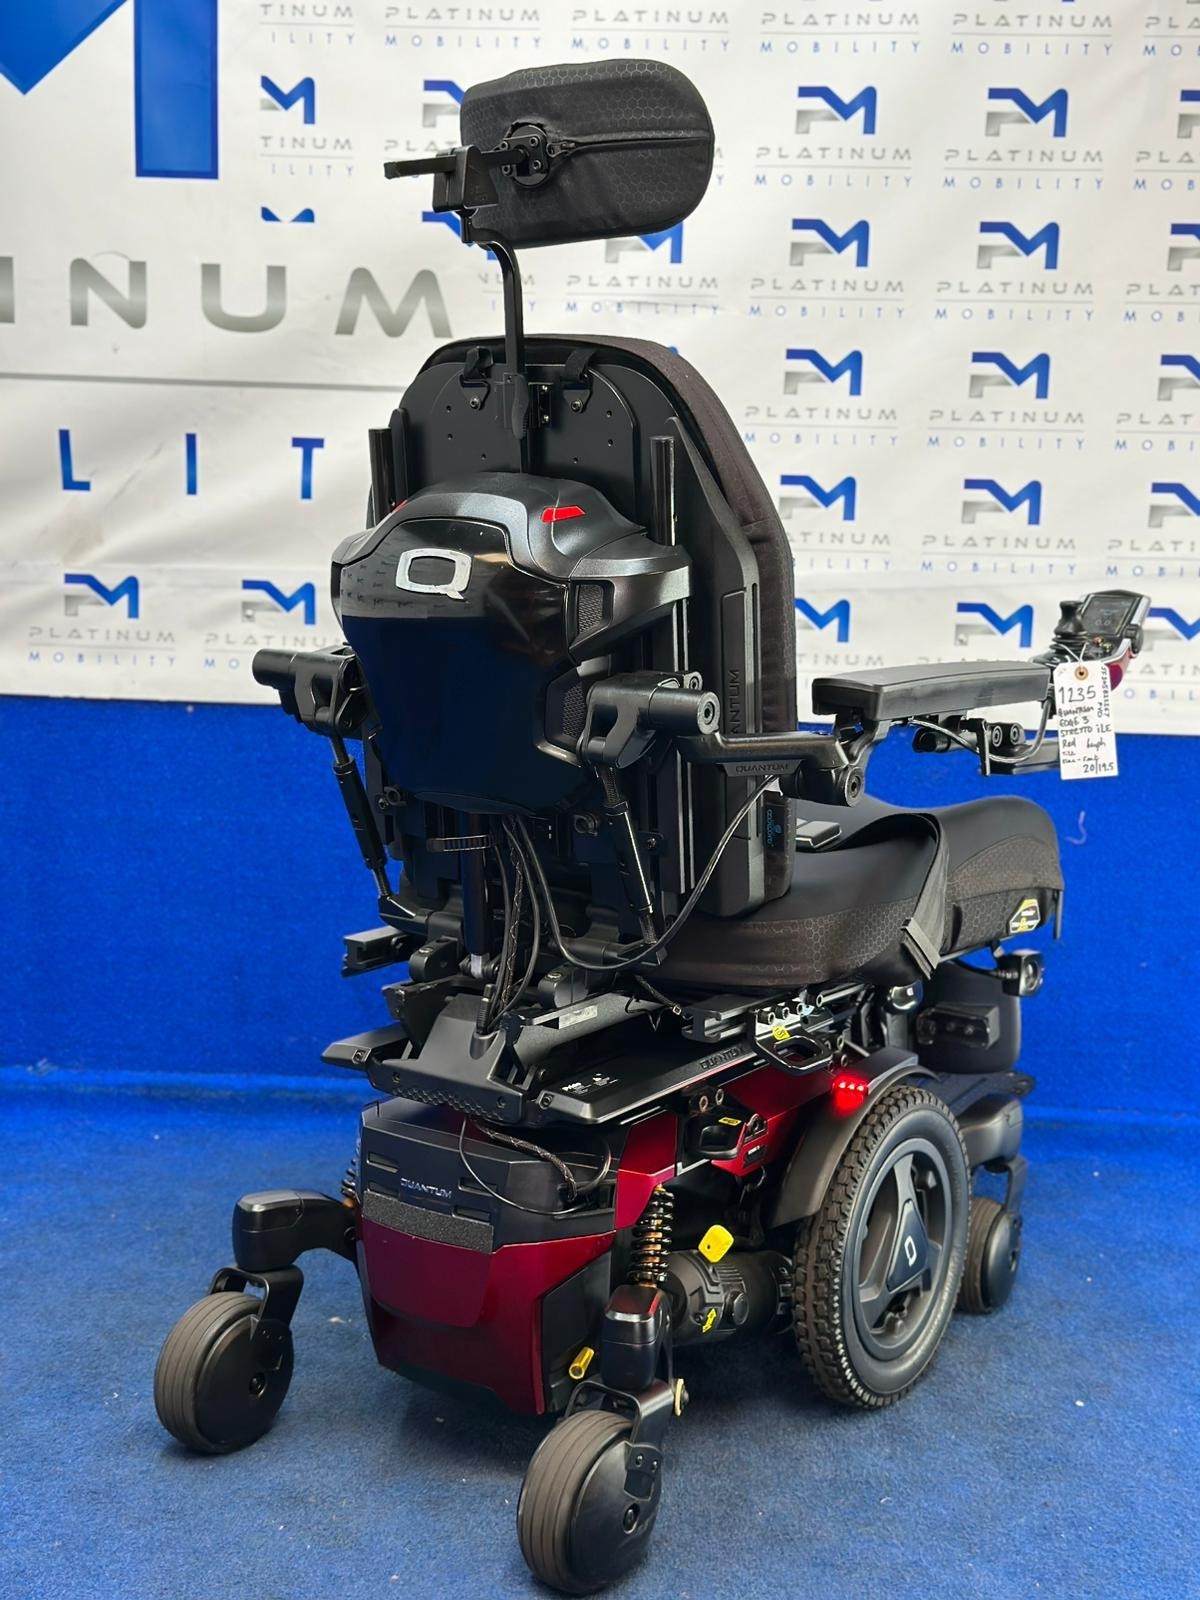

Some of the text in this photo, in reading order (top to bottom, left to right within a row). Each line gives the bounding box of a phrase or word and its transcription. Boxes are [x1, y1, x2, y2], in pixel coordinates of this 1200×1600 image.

[260, 3, 353, 18] TINUM
[385, 6, 540, 21] PLATINUM
[572, 9, 729, 25] PLATINUM
[761, 12, 920, 27] PLATINUM
[953, 14, 1112, 29] PLATINUM
[272, 32, 355, 44] ILITY
[385, 34, 541, 48] MOBILITY
[571, 38, 729, 51] MOBILITY
[760, 41, 920, 54] MOBILITY
[951, 43, 1112, 56] MOBILITY
[260, 136, 353, 150] TINUM
[756, 147, 912, 161] PLATINUM
[944, 149, 1103, 163] PLATINUM
[272, 163, 353, 176] ILITY
[755, 175, 912, 188] MOBILITY
[943, 177, 1103, 190] MOBILITY
[567, 275, 718, 288] PLATINUM
[750, 277, 905, 292] PLATINUM
[937, 280, 1093, 295] PLATINUM
[566, 301, 719, 314] MOBILITY
[750, 304, 905, 318] MOBILITY
[936, 308, 1094, 321] MOBILITY
[745, 405, 897, 421] PLATINUM
[928, 409, 1085, 424] PLATINUM
[744, 432, 898, 446] MOBILITY
[927, 436, 1086, 450] MOBILITY
[922, 535, 1076, 550] PLATINUM
[921, 562, 1077, 576] MOBILITY
[28, 627, 176, 643] PLATINUM
[28, 651, 177, 667] MOBILITY
[400, 1177, 453, 1200] QUANTUM
